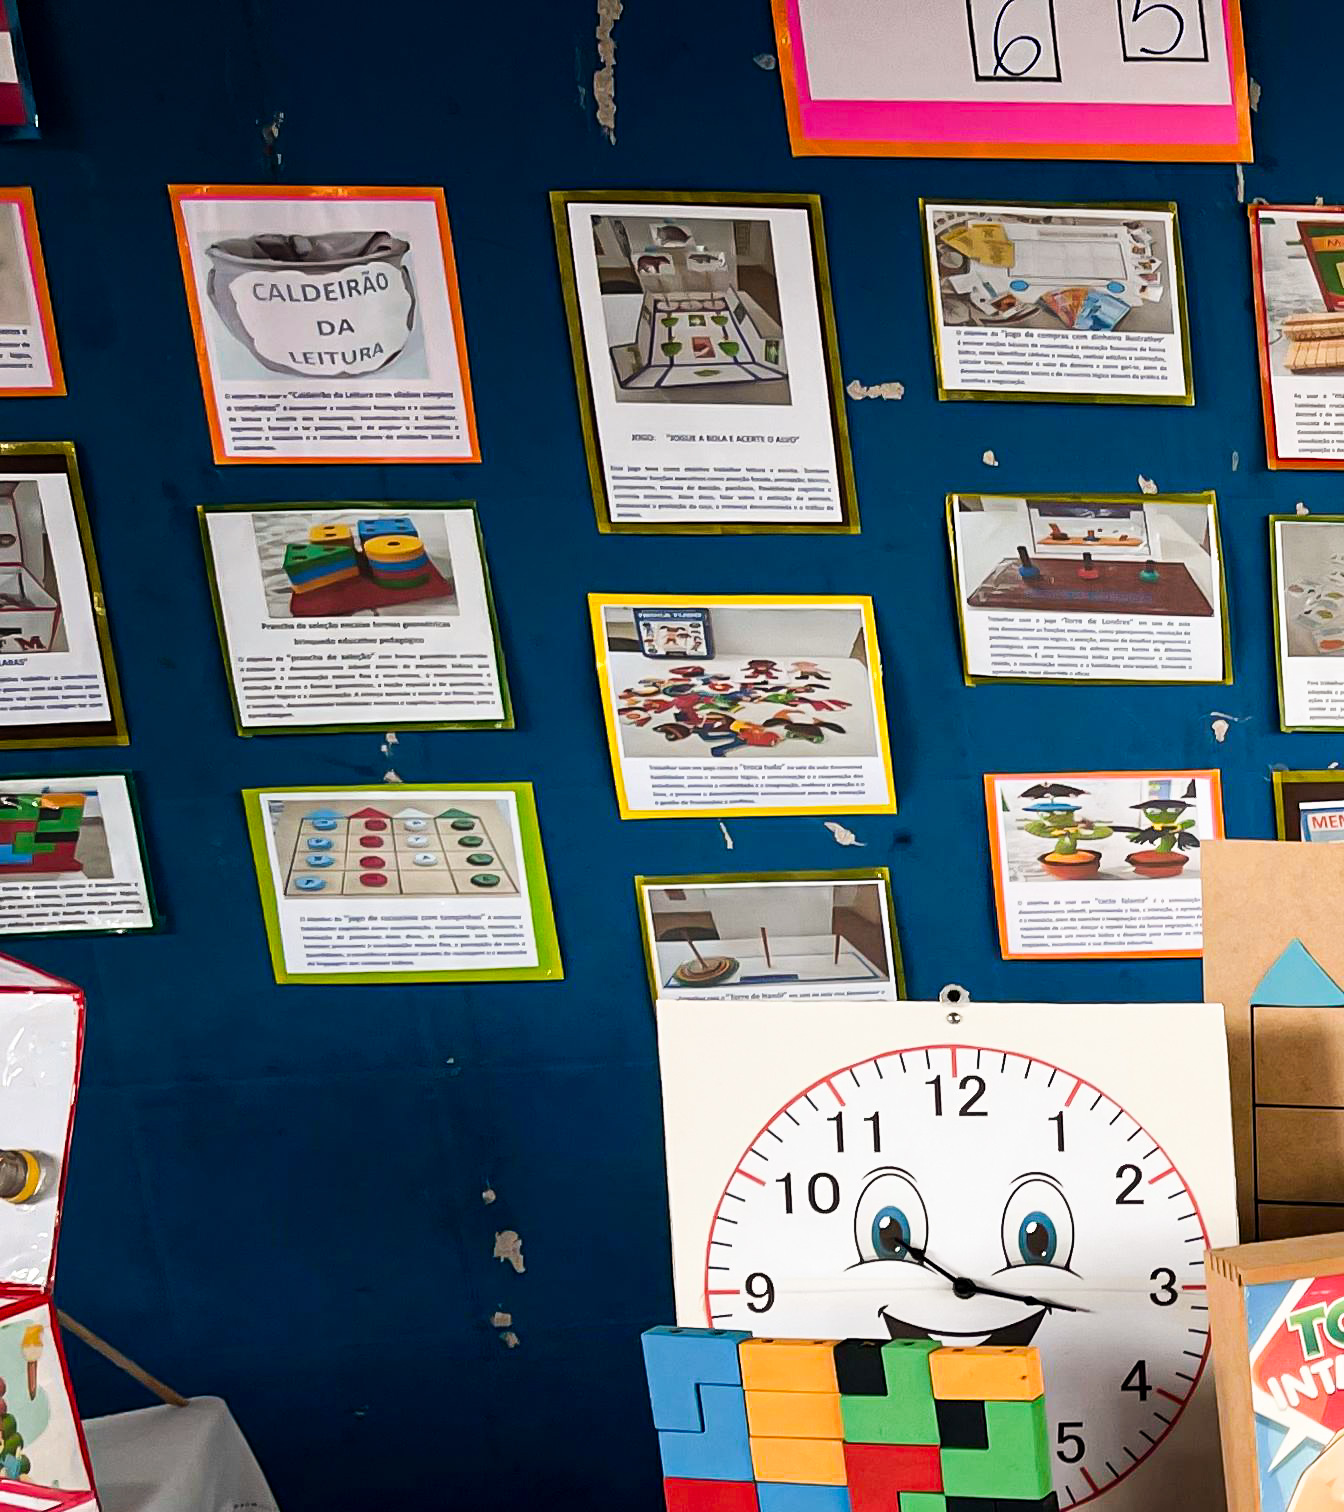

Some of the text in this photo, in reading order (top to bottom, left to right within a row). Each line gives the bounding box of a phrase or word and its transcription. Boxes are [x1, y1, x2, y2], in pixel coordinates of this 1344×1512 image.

[992, 0, 1041, 76] 6
[252, 270, 390, 304] CALDEIRÃO
[316, 319, 355, 337] DA
[288, 340, 385, 368] LEITURA
[926, 1075, 989, 1117] 12
[827, 1111, 881, 1152] 11
[1048, 1112, 1065, 1152] 1
[776, 1172, 840, 1214] 10
[1115, 1164, 1145, 1205] 2
[745, 1272, 775, 1313] 9
[1149, 1267, 1178, 1305] 3
[1120, 1360, 1153, 1401] 4
[1056, 1421, 1085, 1463] 5
